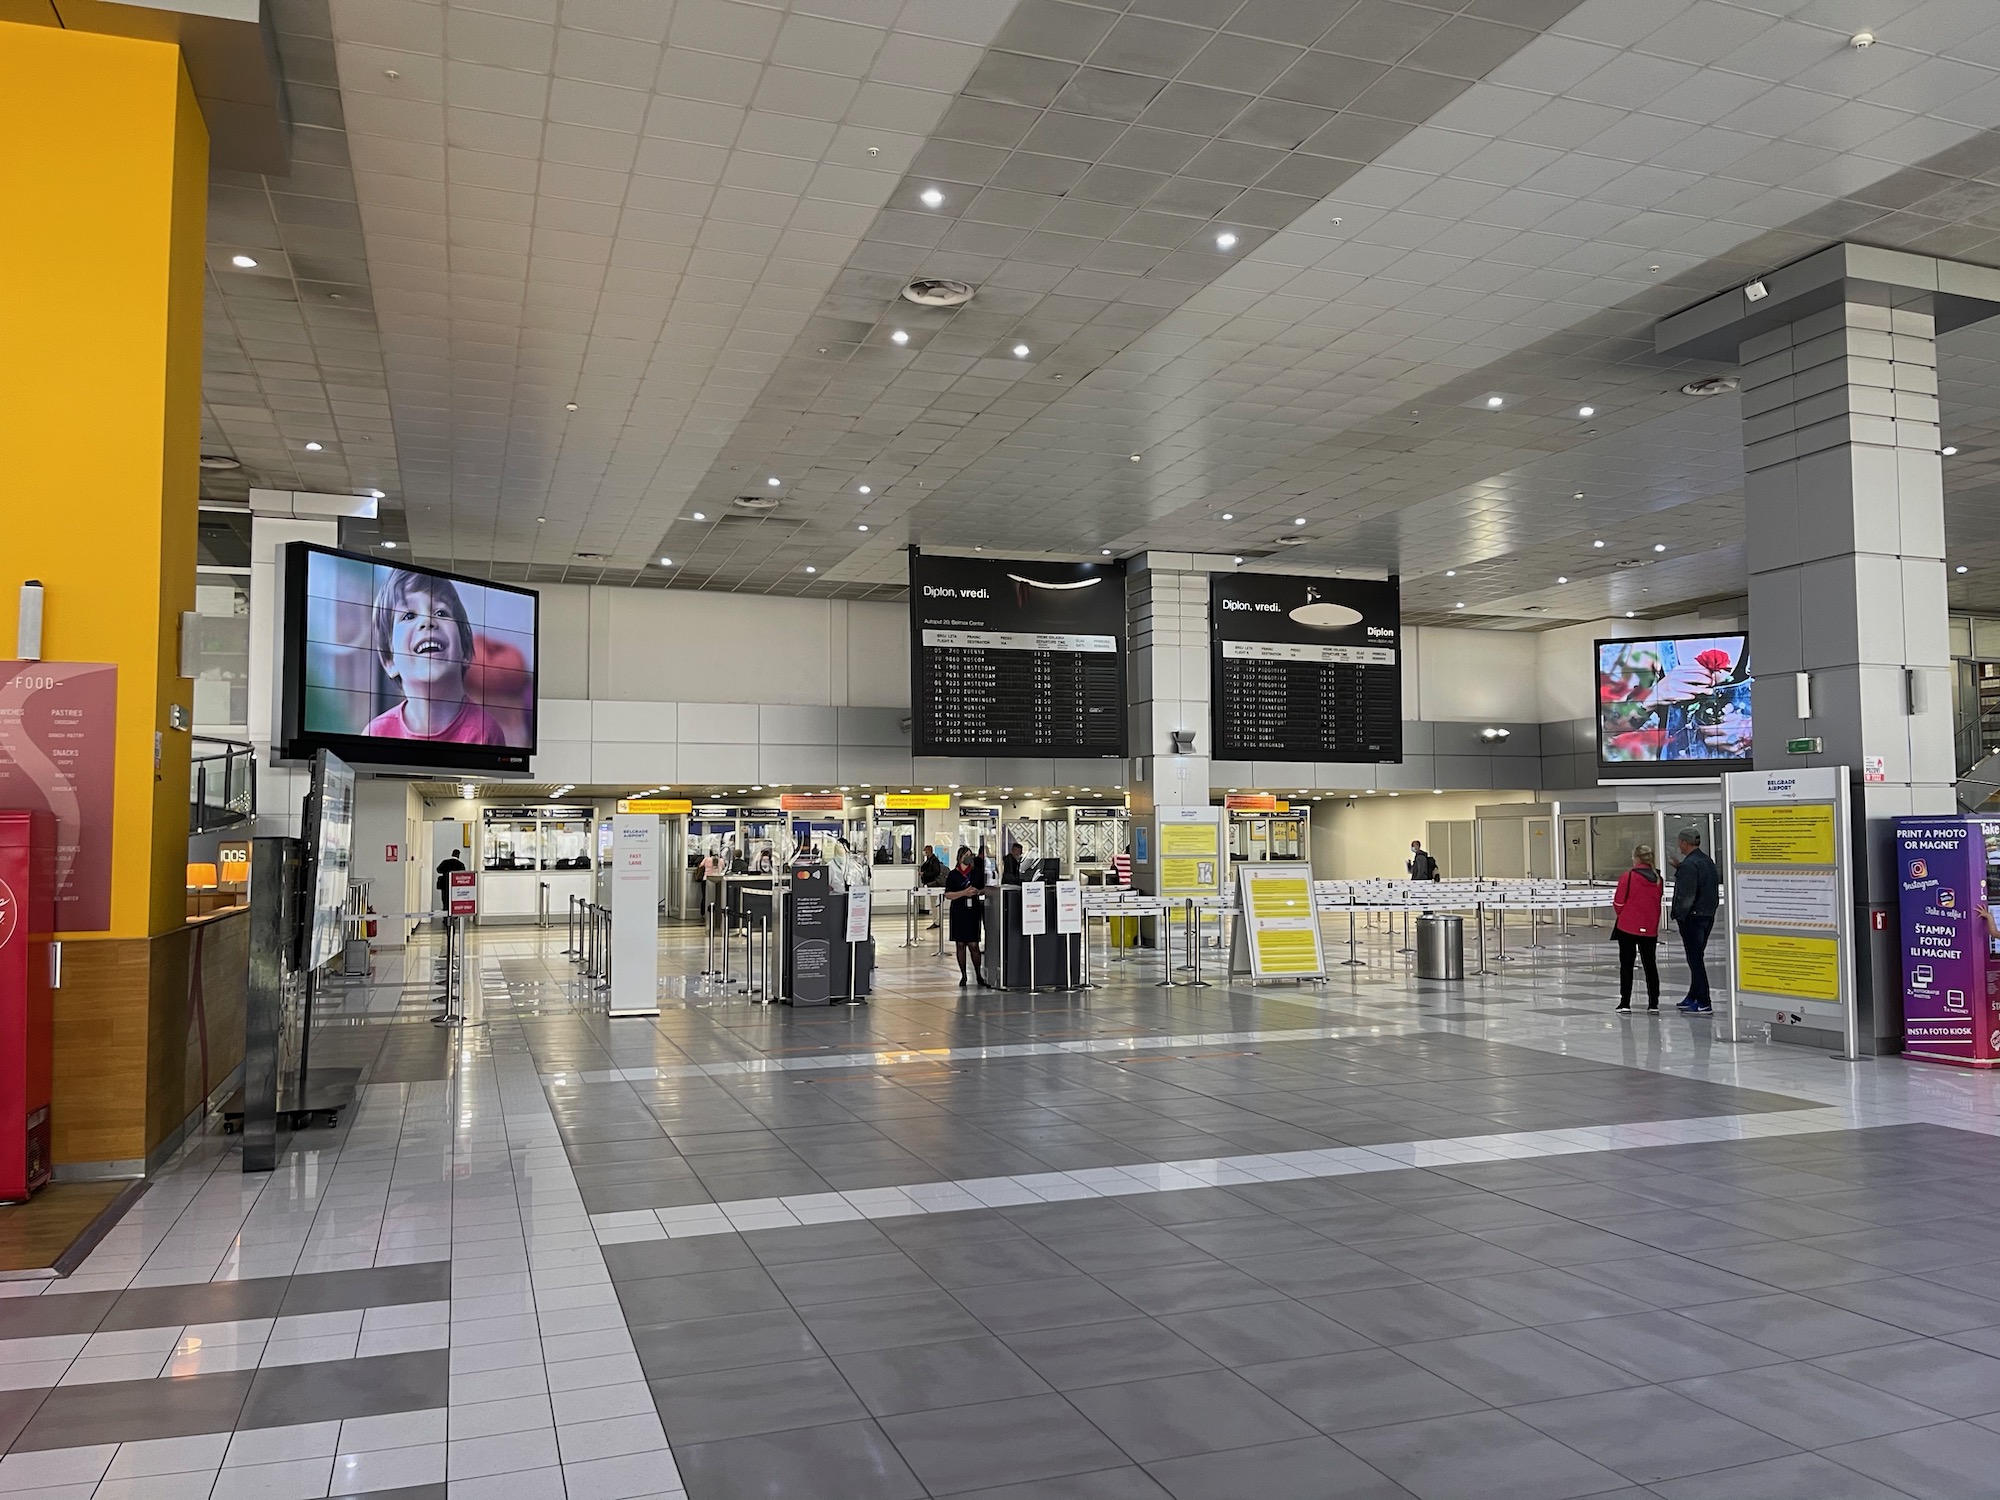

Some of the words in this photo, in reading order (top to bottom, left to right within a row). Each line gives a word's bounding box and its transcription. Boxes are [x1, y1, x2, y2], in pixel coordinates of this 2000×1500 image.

[923, 586, 958, 598] Diplon,
[960, 588, 990, 598] vredi.
[1222, 600, 1252, 611] Diplon,
[1255, 603, 1281, 612] vredi.
[1367, 626, 1394, 637] Diplon
[1896, 830, 1923, 838] PRINT
[1924, 830, 1932, 838] A
[1933, 829, 1967, 838] PHOTO
[1980, 823, 2000, 835] Take
[1904, 841, 1918, 849] OR
[1920, 841, 1959, 850] MAGNET
[1903, 879, 1940, 891] Instagram
[1915, 923, 1956, 937] ŠTAMPAJ
[1920, 937, 1951, 947] FOTKU
[1910, 948, 1920, 956] ILI
[1922, 948, 1962, 959] MAGNET
